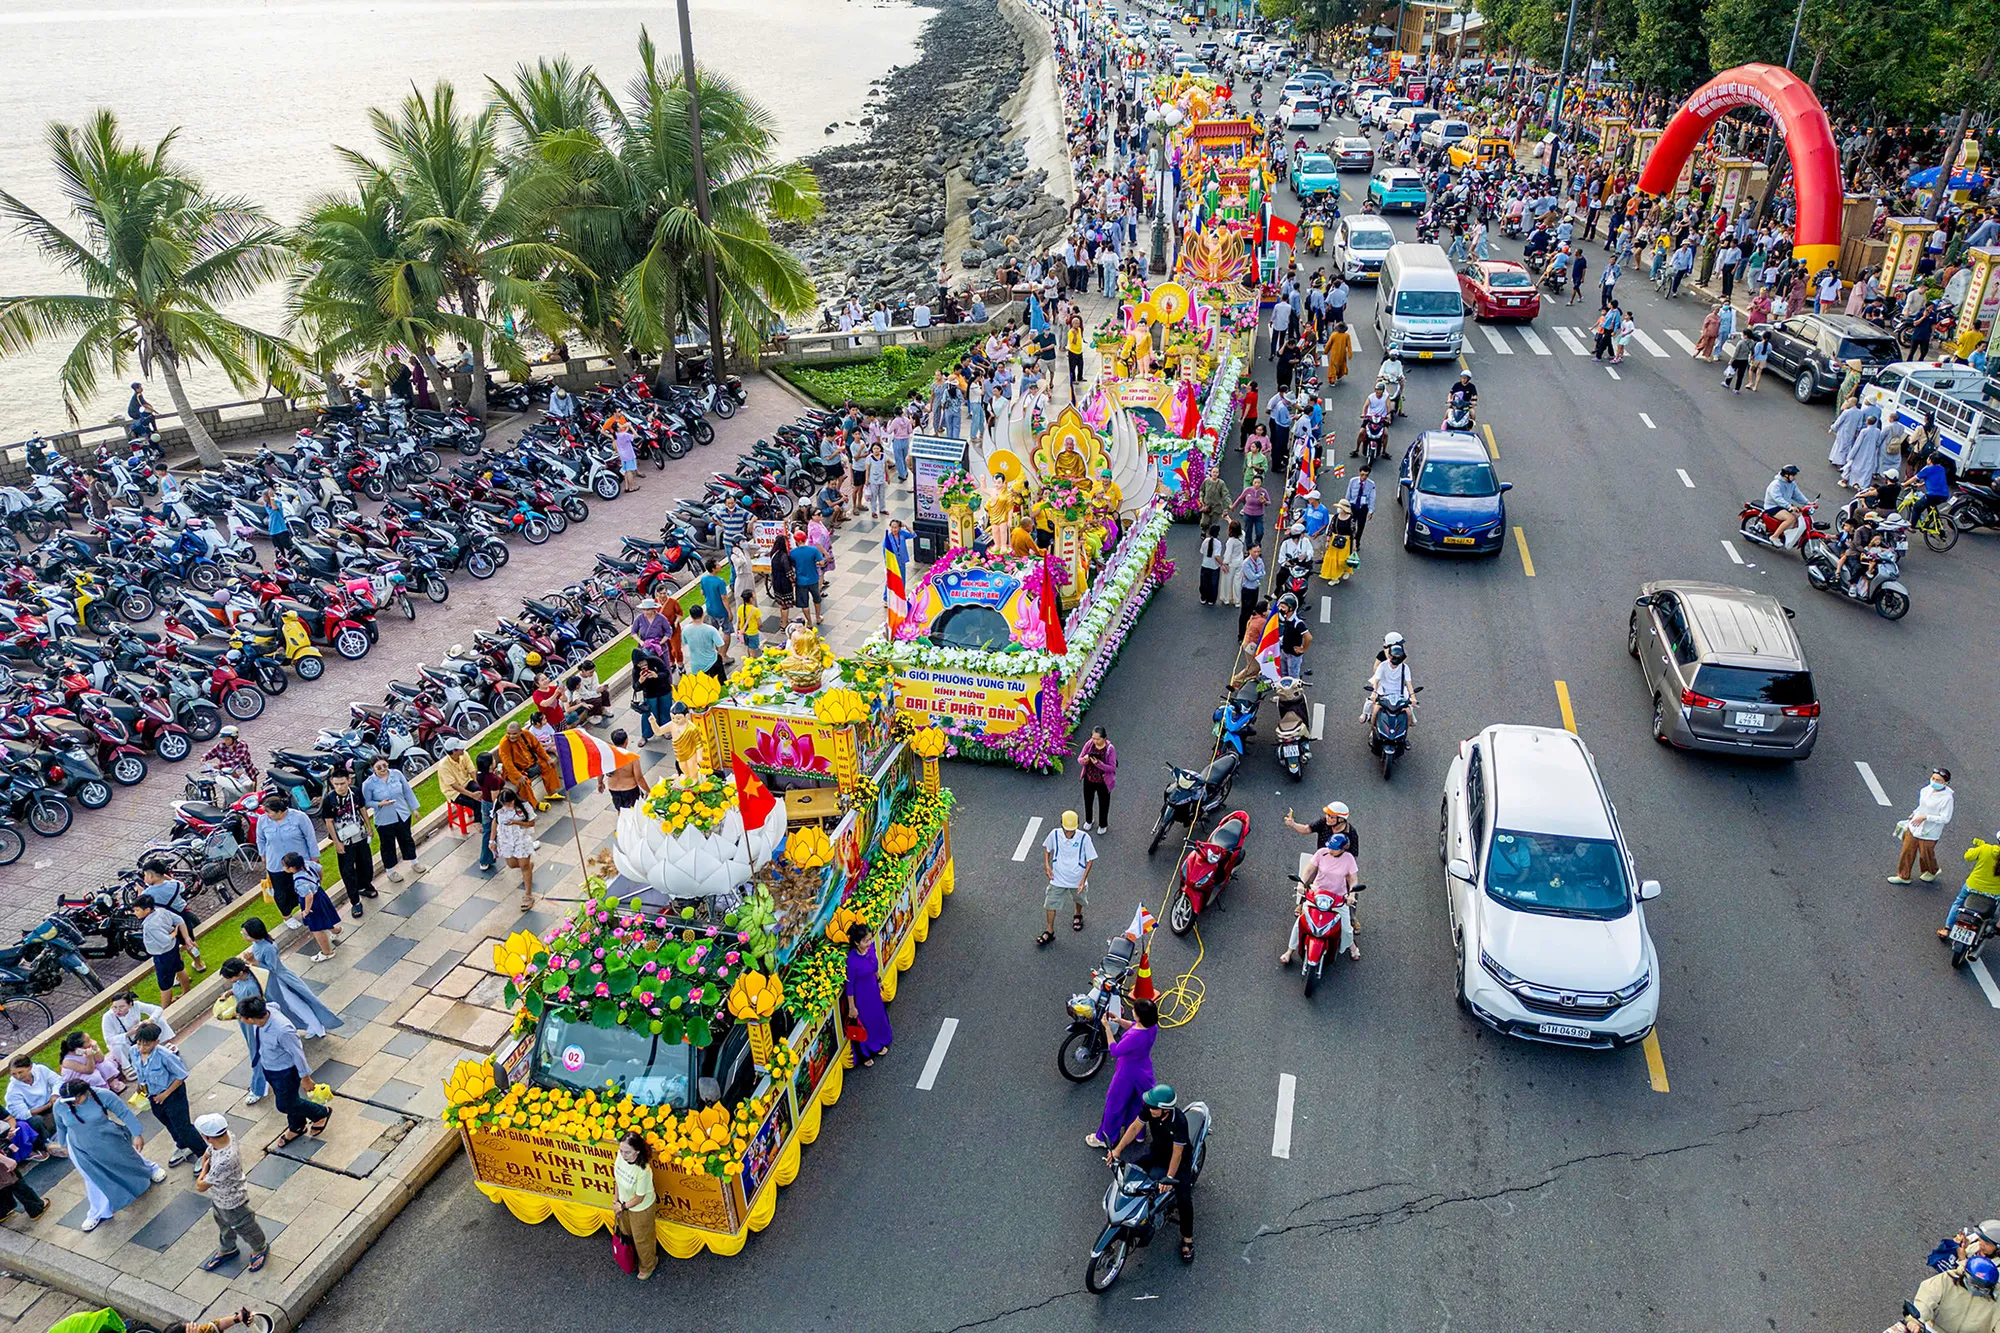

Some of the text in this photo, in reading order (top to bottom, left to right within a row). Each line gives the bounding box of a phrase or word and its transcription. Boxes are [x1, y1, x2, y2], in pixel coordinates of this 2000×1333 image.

[933, 686, 986, 700] KÍNH MỪNG
[905, 697, 1016, 721] ĐẠI LỄ PHẬT ĐẢN
[568, 1051, 580, 1063] 02
[532, 1136, 554, 1149] NAM
[582, 1144, 614, 1160] THÀNH
[532, 1150, 586, 1172] KÍNH
[505, 1161, 542, 1181] ĐẠI
[548, 1167, 575, 1187] LỄ
